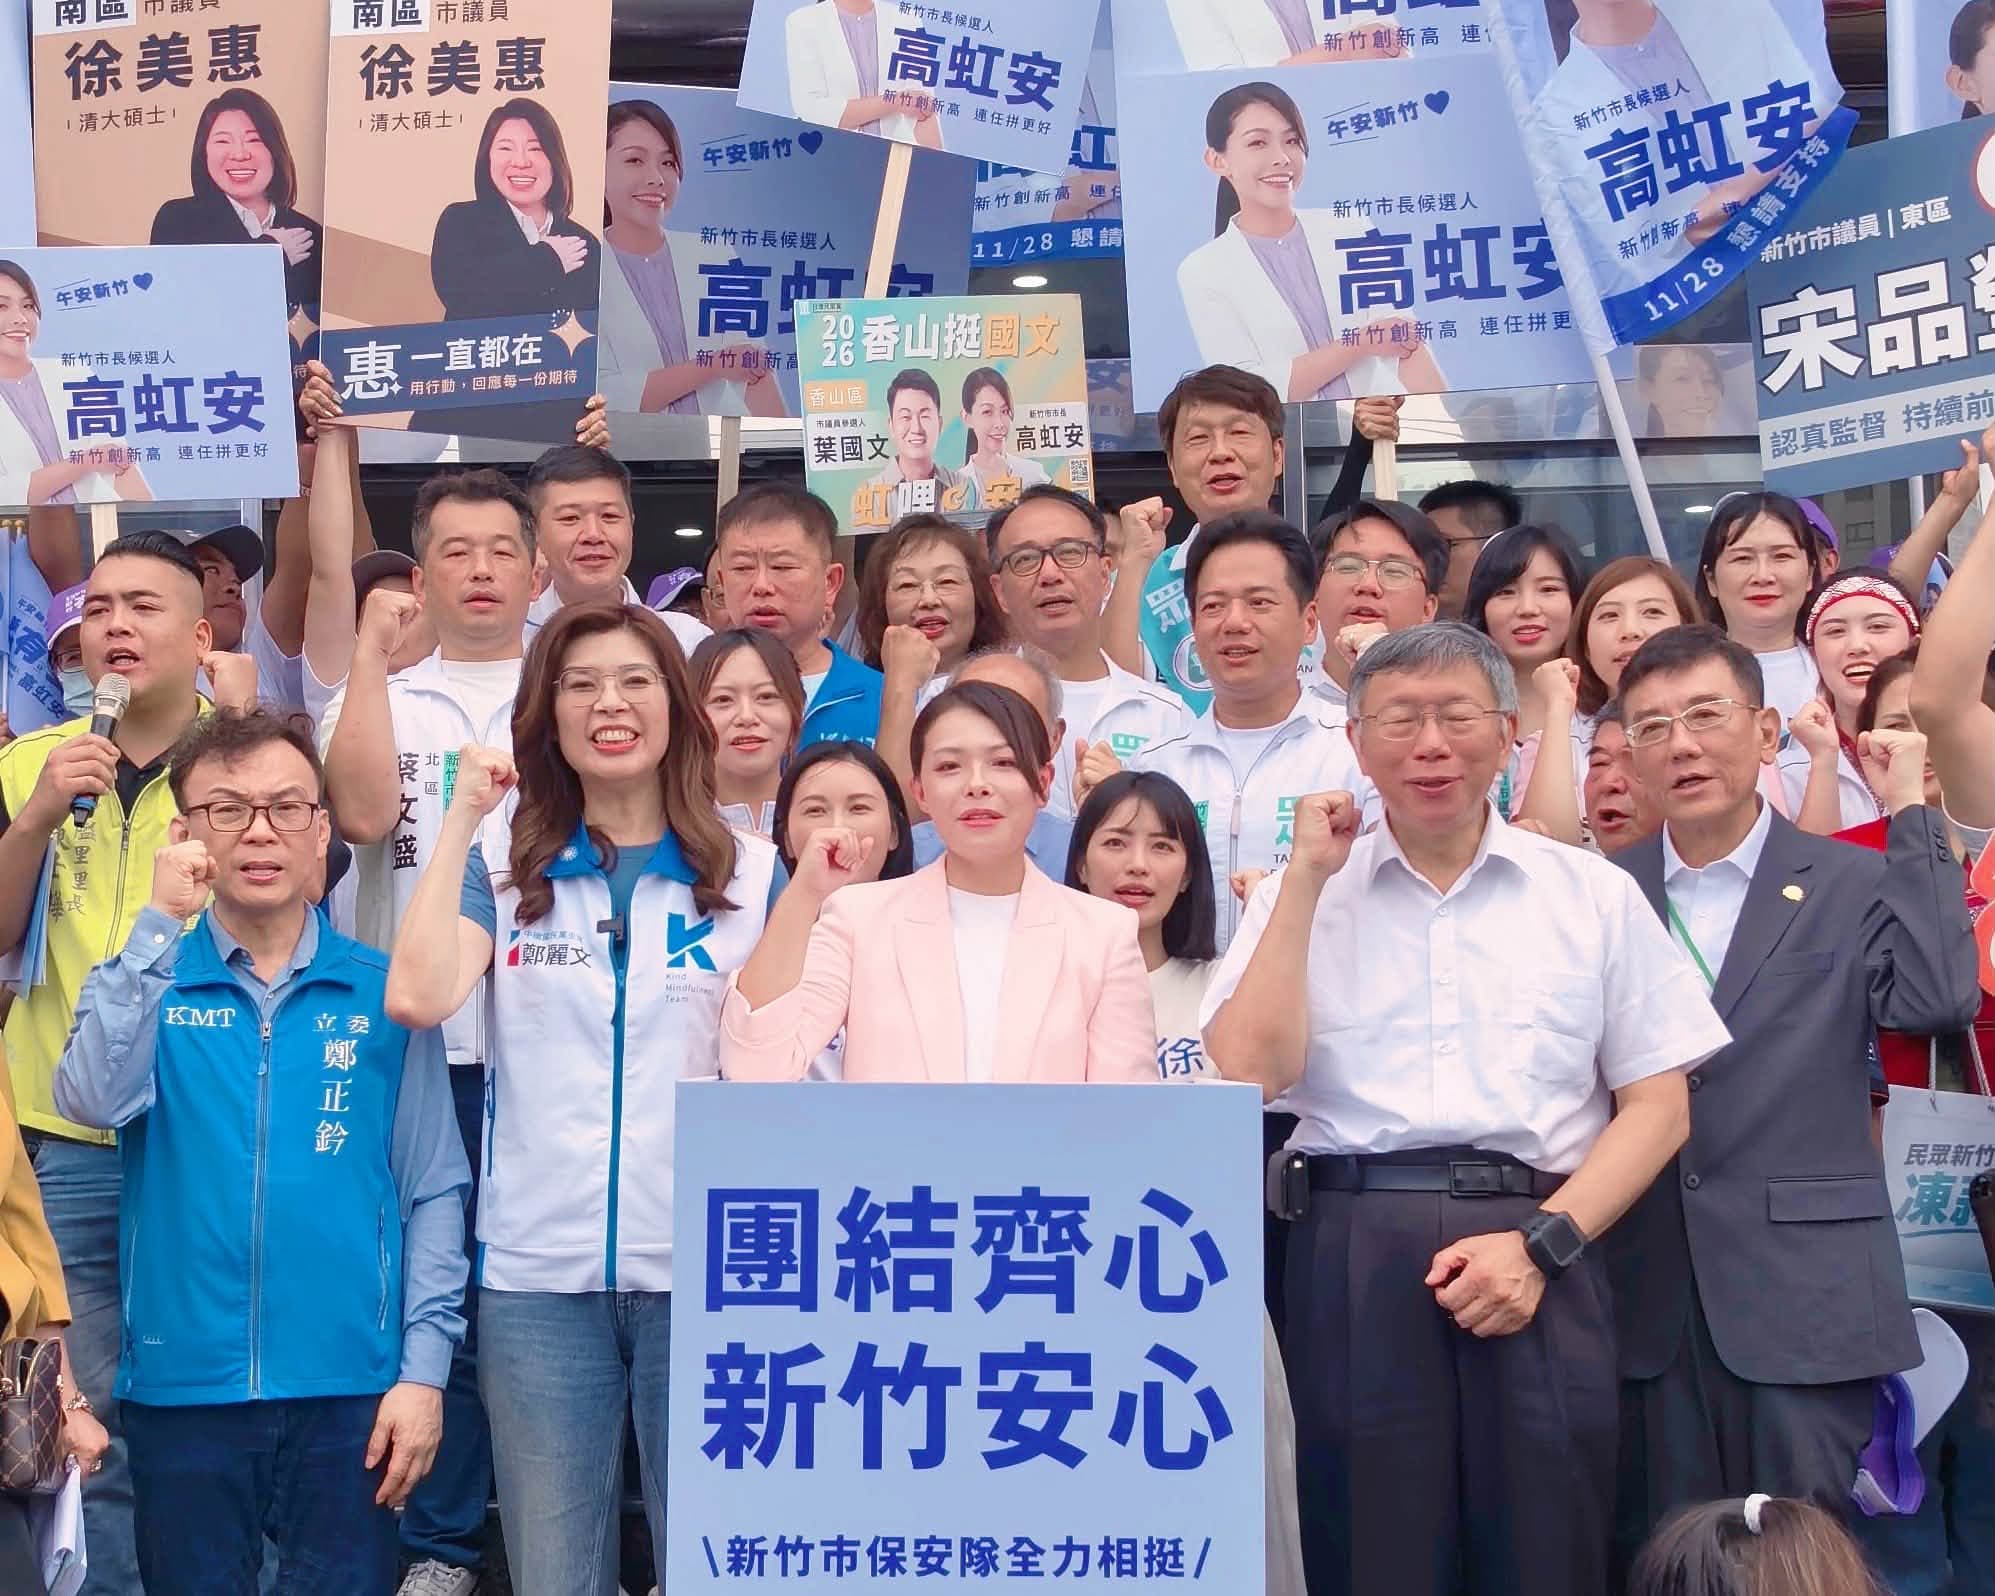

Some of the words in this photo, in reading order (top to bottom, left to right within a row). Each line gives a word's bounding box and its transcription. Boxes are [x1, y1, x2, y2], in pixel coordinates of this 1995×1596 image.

[353, 0, 422, 29] 南區
[436, 1, 509, 24] 市議員
[899, 2, 994, 34] 新竹市長候選人
[1324, 26, 1439, 51] 新竹創新高
[65, 24, 262, 100] 徐美惠
[360, 37, 546, 100] 徐美惠
[887, 27, 1062, 112] 高虹安
[882, 88, 960, 118] 新竹創新高
[1573, 78, 1690, 131] 新竹市長候選人
[79, 104, 166, 133] 清大碩士
[370, 110, 454, 133] 清大碩士
[1328, 101, 1418, 139] 午安新竹
[703, 137, 793, 166] 午安新竹
[1584, 79, 1818, 223] 高虹安
[974, 185, 1070, 211] 新竹創新高
[1333, 192, 1478, 218] 新竹市長候選人
[700, 227, 836, 250] 新竹市長候選人
[1760, 213, 1881, 263] 新竹市議員
[1900, 196, 1952, 230] 東區
[973, 233, 1053, 260] 11/28
[1335, 218, 1565, 315] 高虹安
[55, 278, 129, 307] 午安新竹
[1644, 257, 1724, 320] 11/28
[862, 312, 1061, 363] 香山挺國文
[1341, 320, 1457, 347] 新竹創新高
[61, 350, 176, 367] 新竹市長候選人
[411, 333, 543, 371] 一直都在
[341, 340, 403, 400] 惠
[62, 370, 265, 441] 高虹安
[809, 386, 865, 408] 香山區
[813, 433, 890, 463] 葉國文
[1015, 422, 1085, 452] 高虹安
[1770, 410, 1887, 459] 認真監督
[68, 446, 161, 465] 新竹創新高
[177, 442, 269, 461] 連任拼更好
[522, 943, 592, 968] 鄭麗文
[165, 1006, 236, 1027] KMT
[313, 1013, 370, 1034] 立委
[1158, 1038, 1203, 1079] 徐
[705, 1185, 1229, 1314] 團結齊心
[700, 1341, 1234, 1471] 新竹安心
